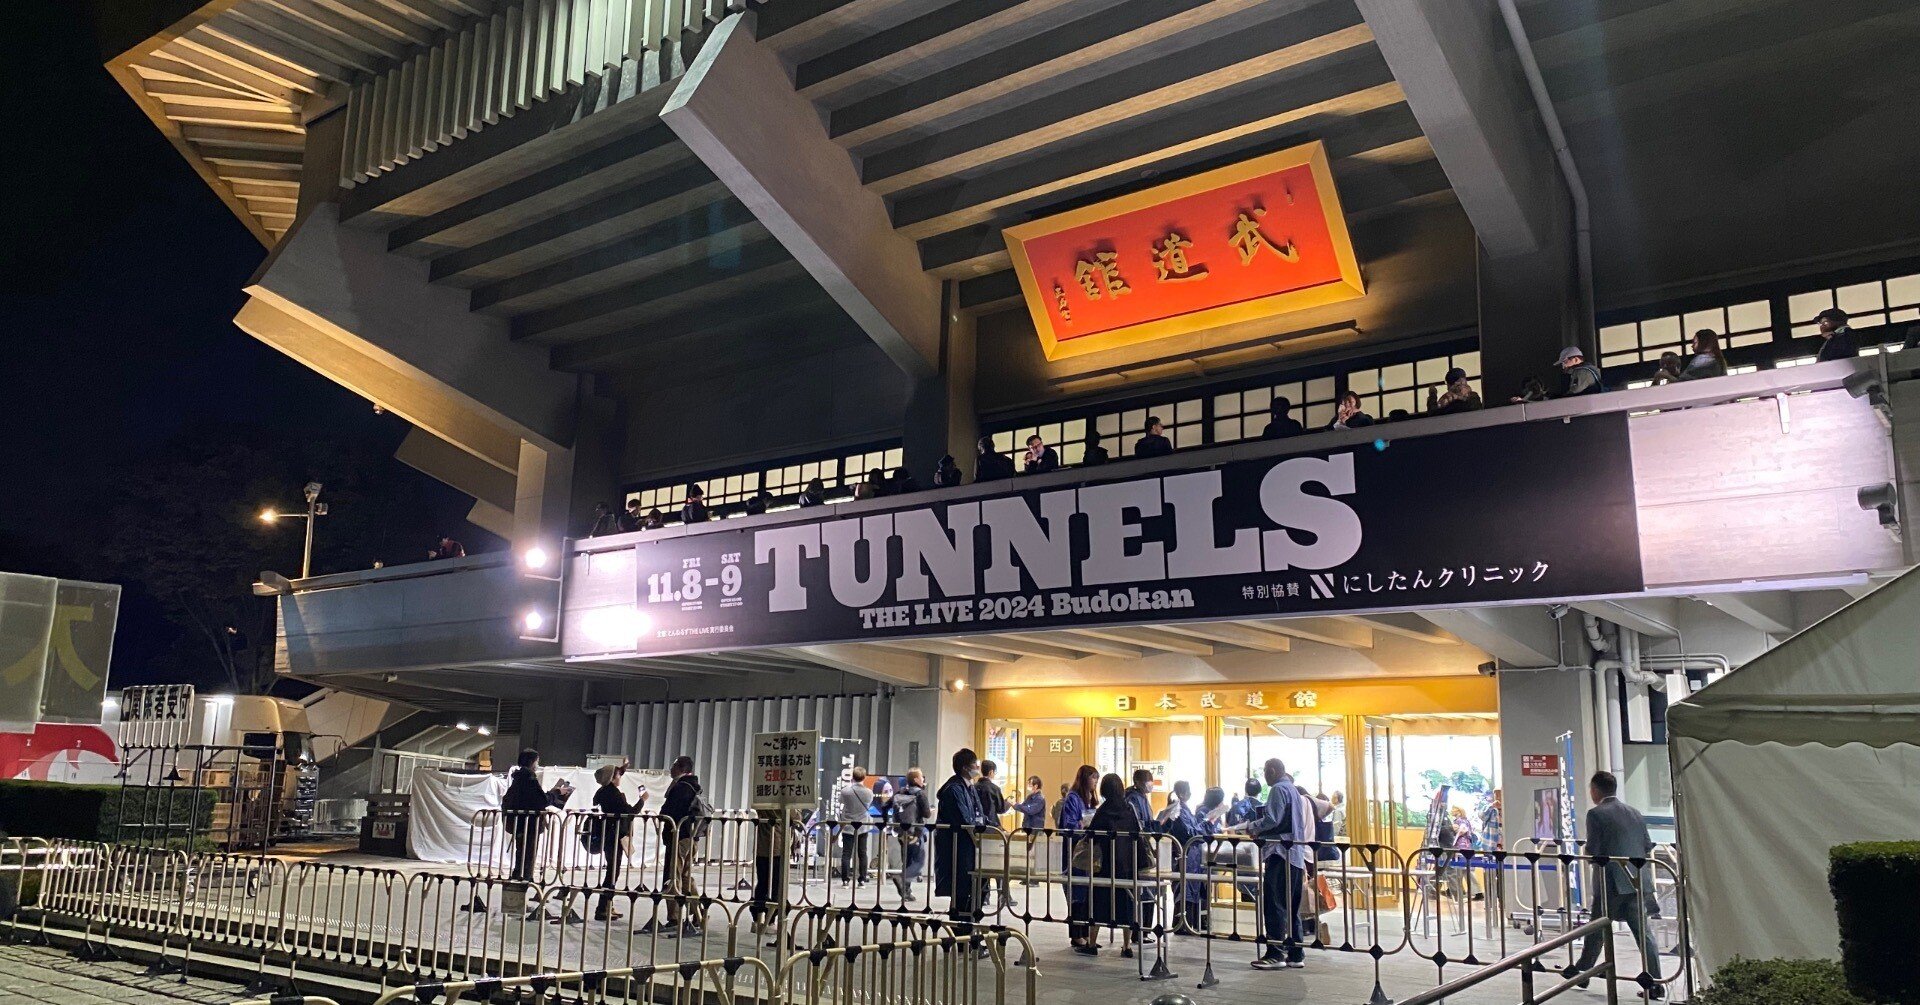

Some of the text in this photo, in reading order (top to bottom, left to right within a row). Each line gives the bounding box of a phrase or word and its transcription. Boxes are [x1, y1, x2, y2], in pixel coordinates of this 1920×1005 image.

[754, 452, 1363, 613] TUNNELS
[683, 552, 741, 569] FRI SAT
[1242, 582, 1300, 600] 特別協賛
[1343, 561, 1549, 594] にしたんクリニック
[858, 587, 1195, 629] THE LIVE 2024 Budokan
[1118, 690, 1318, 711] 日本武道館
[757, 753, 812, 768] 写真を撮る方は
[756, 784, 811, 797] 撮影して下さい
